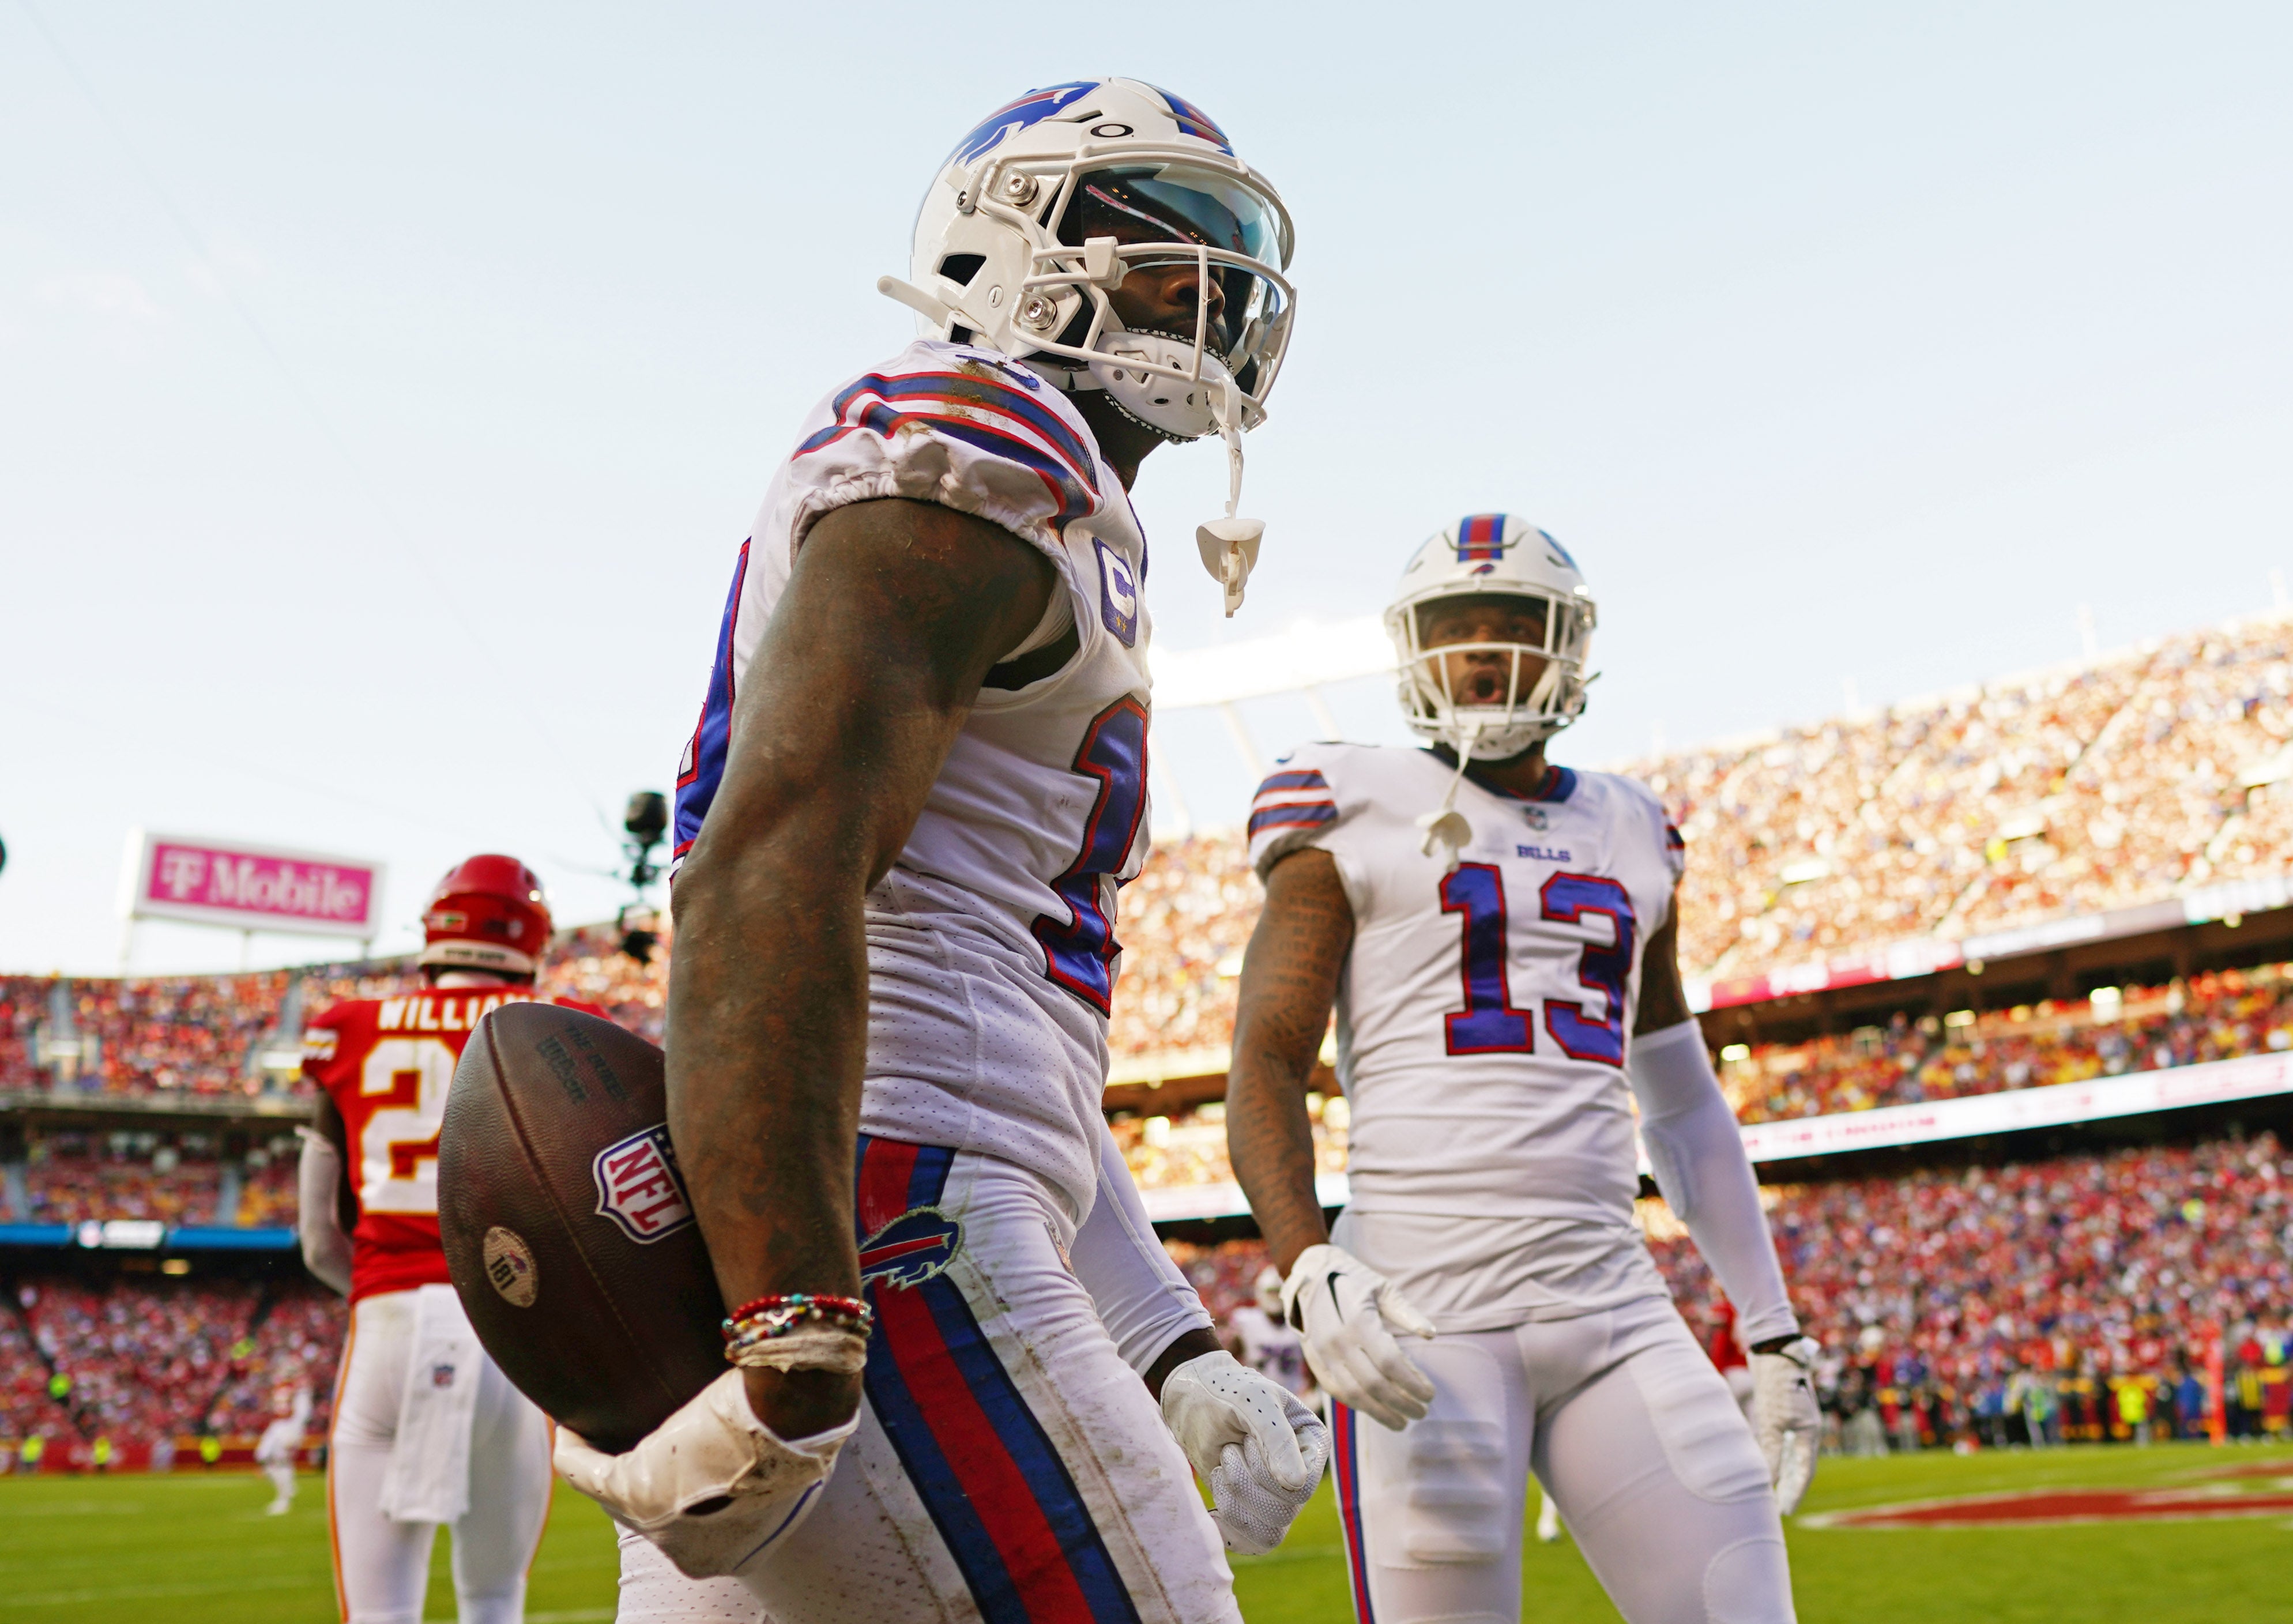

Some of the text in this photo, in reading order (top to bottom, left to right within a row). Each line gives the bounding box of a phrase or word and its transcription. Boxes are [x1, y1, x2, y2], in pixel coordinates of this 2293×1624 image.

[209, 856, 360, 915] Mobile
[1439, 861, 1636, 1068] 13
[609, 1142, 682, 1231] NFL
[490, 1255, 517, 1290] 181
